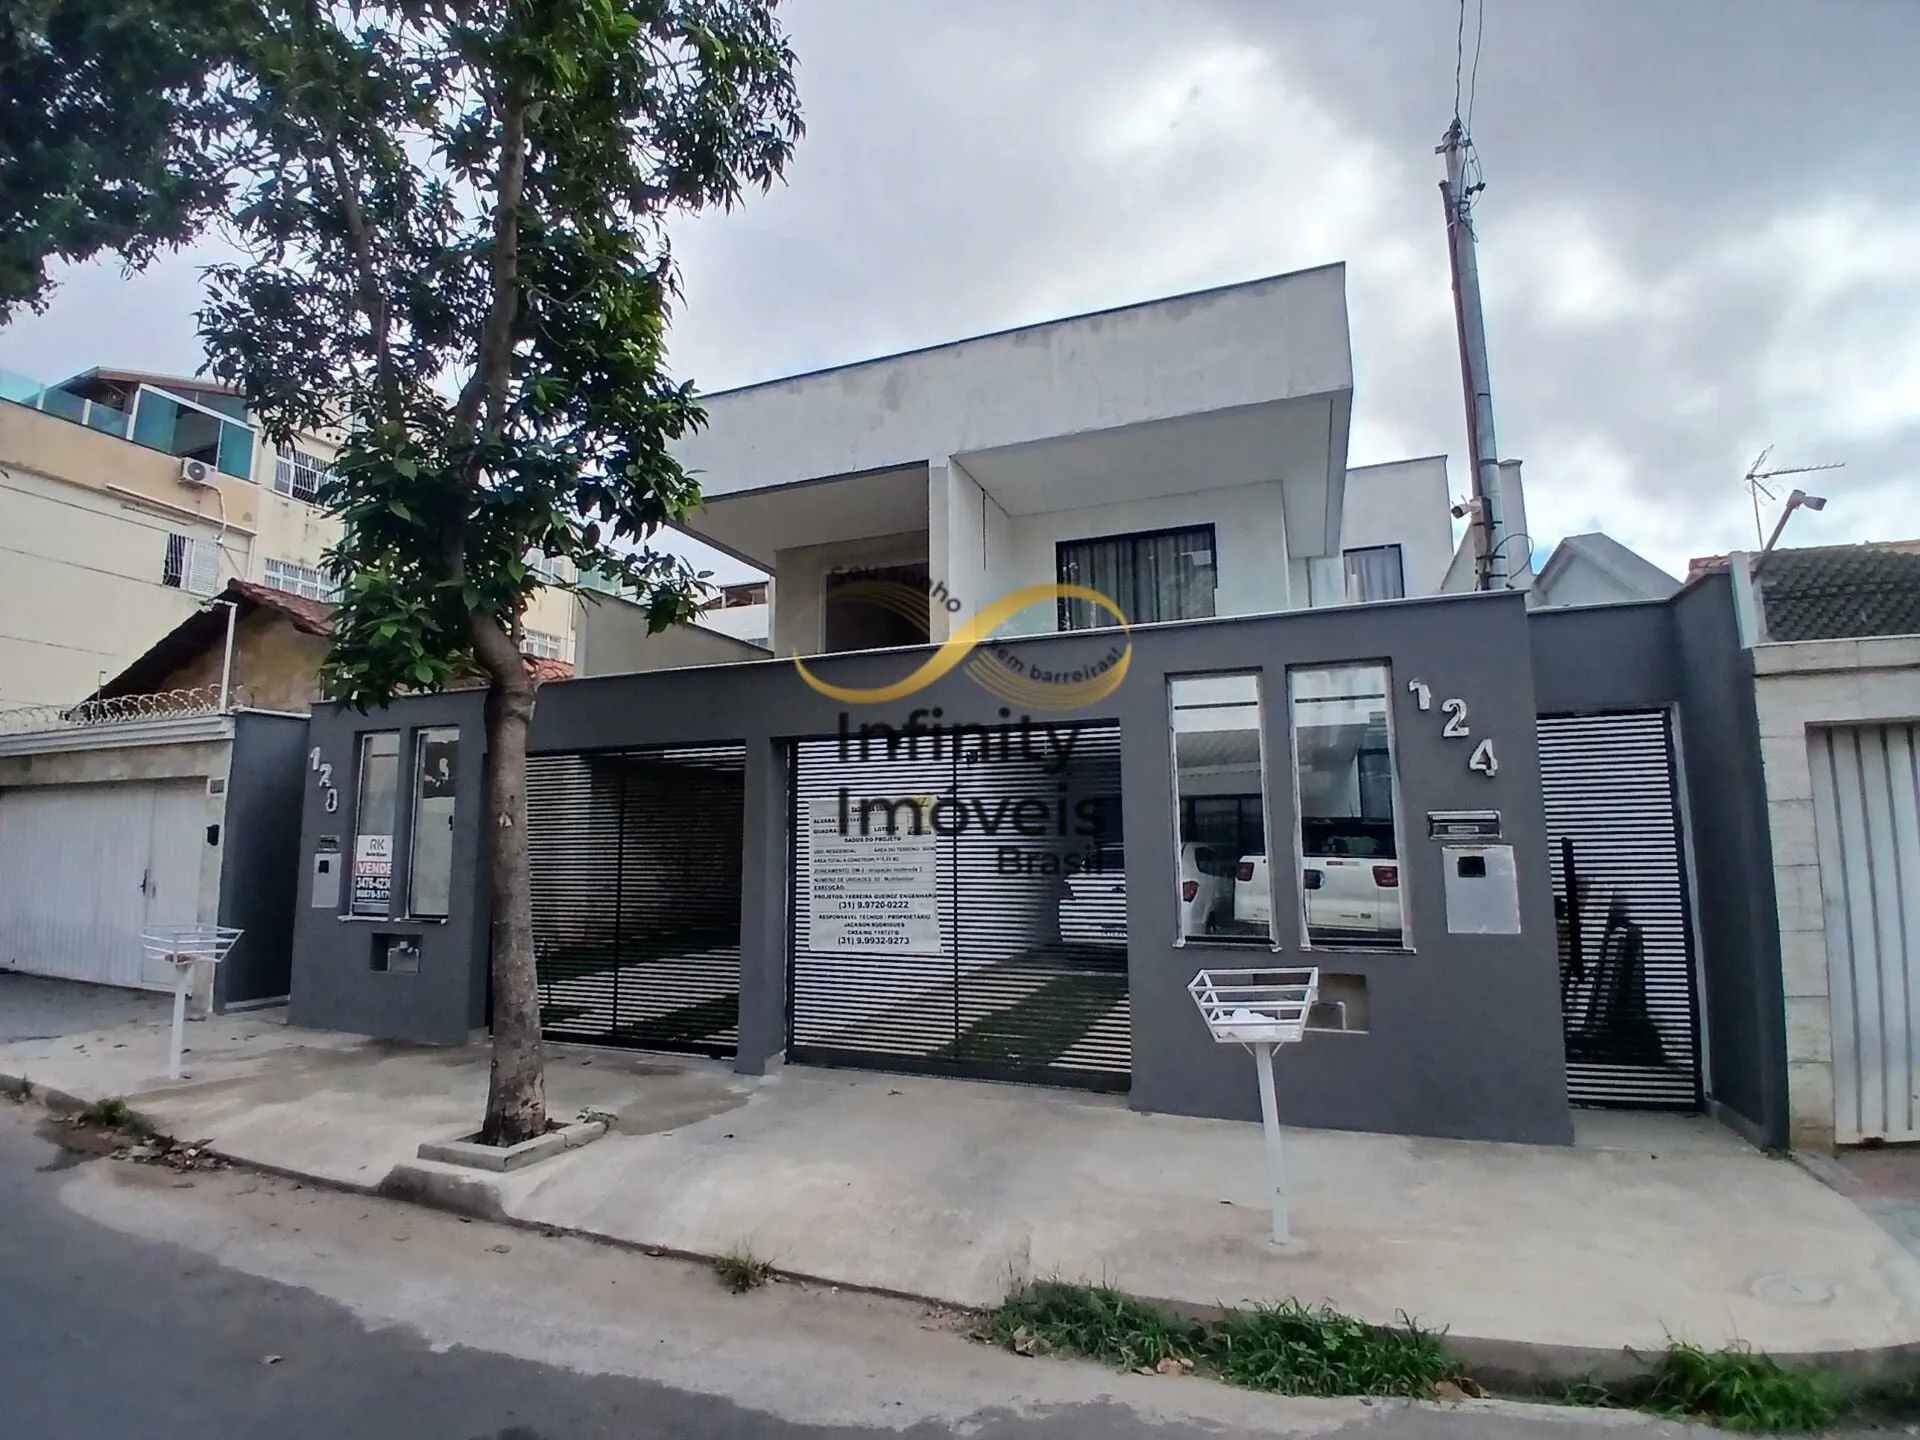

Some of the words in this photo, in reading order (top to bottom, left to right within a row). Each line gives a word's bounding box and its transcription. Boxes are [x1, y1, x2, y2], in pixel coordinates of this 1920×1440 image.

[1408, 678, 1499, 777] 124
[309, 746, 338, 813] 120
[370, 839, 384, 850] RK
[839, 901, 855, 910] (31)
[838, 937, 854, 946] (31)
